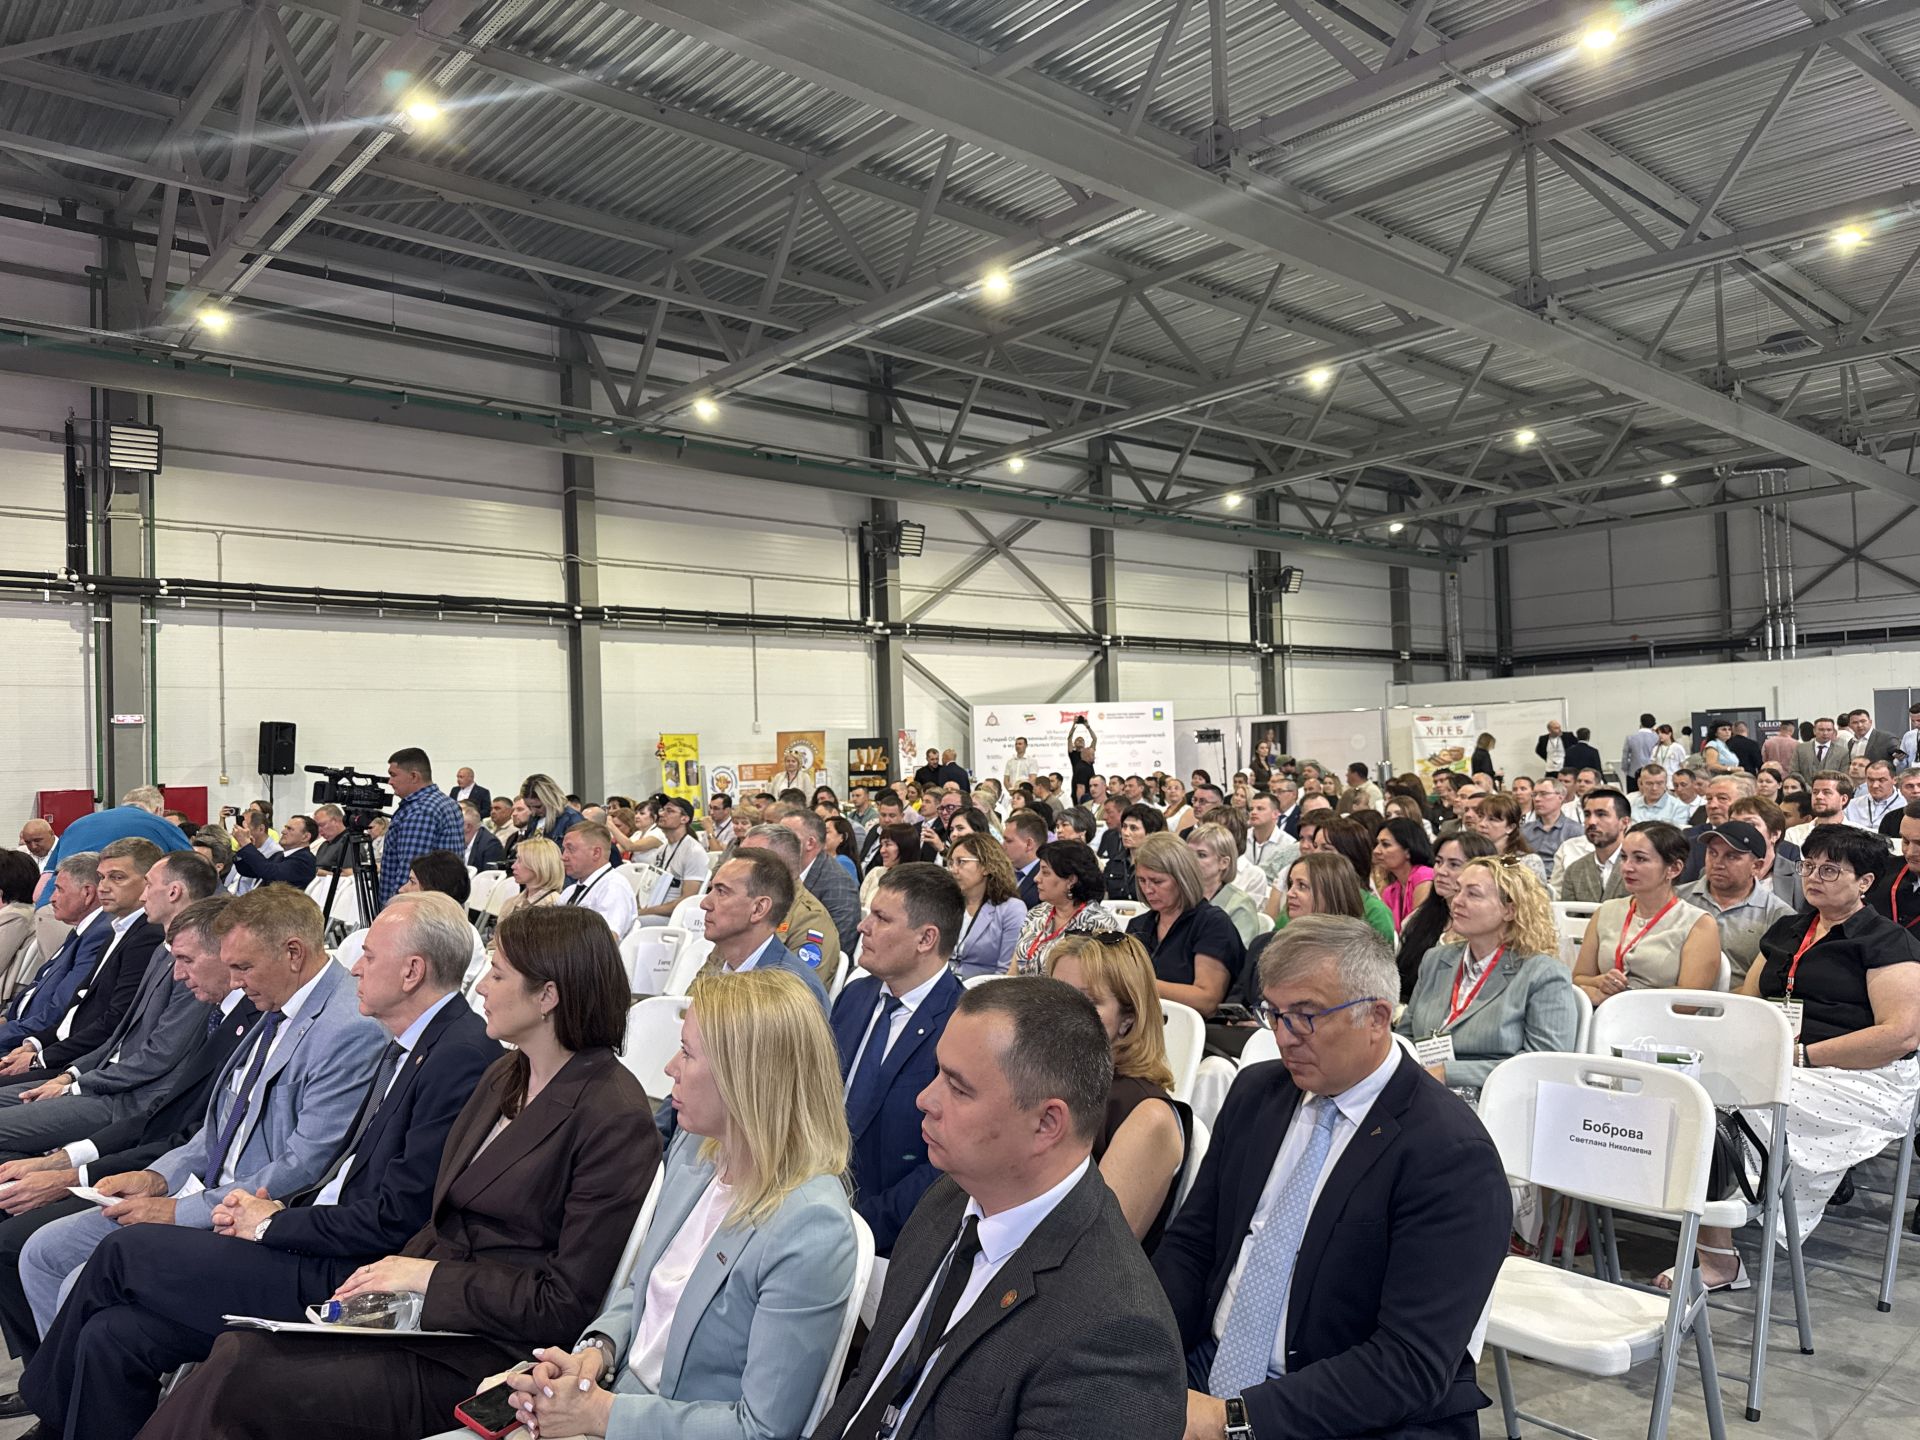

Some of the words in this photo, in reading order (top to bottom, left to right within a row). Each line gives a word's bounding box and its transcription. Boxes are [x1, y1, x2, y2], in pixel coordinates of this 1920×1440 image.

[1426, 725, 1464, 736] ХЛЕБ
[1582, 1118, 1644, 1140] Боброва
[1569, 1134, 1607, 1148] Светлана
[1608, 1141, 1652, 1156] Николаевна
